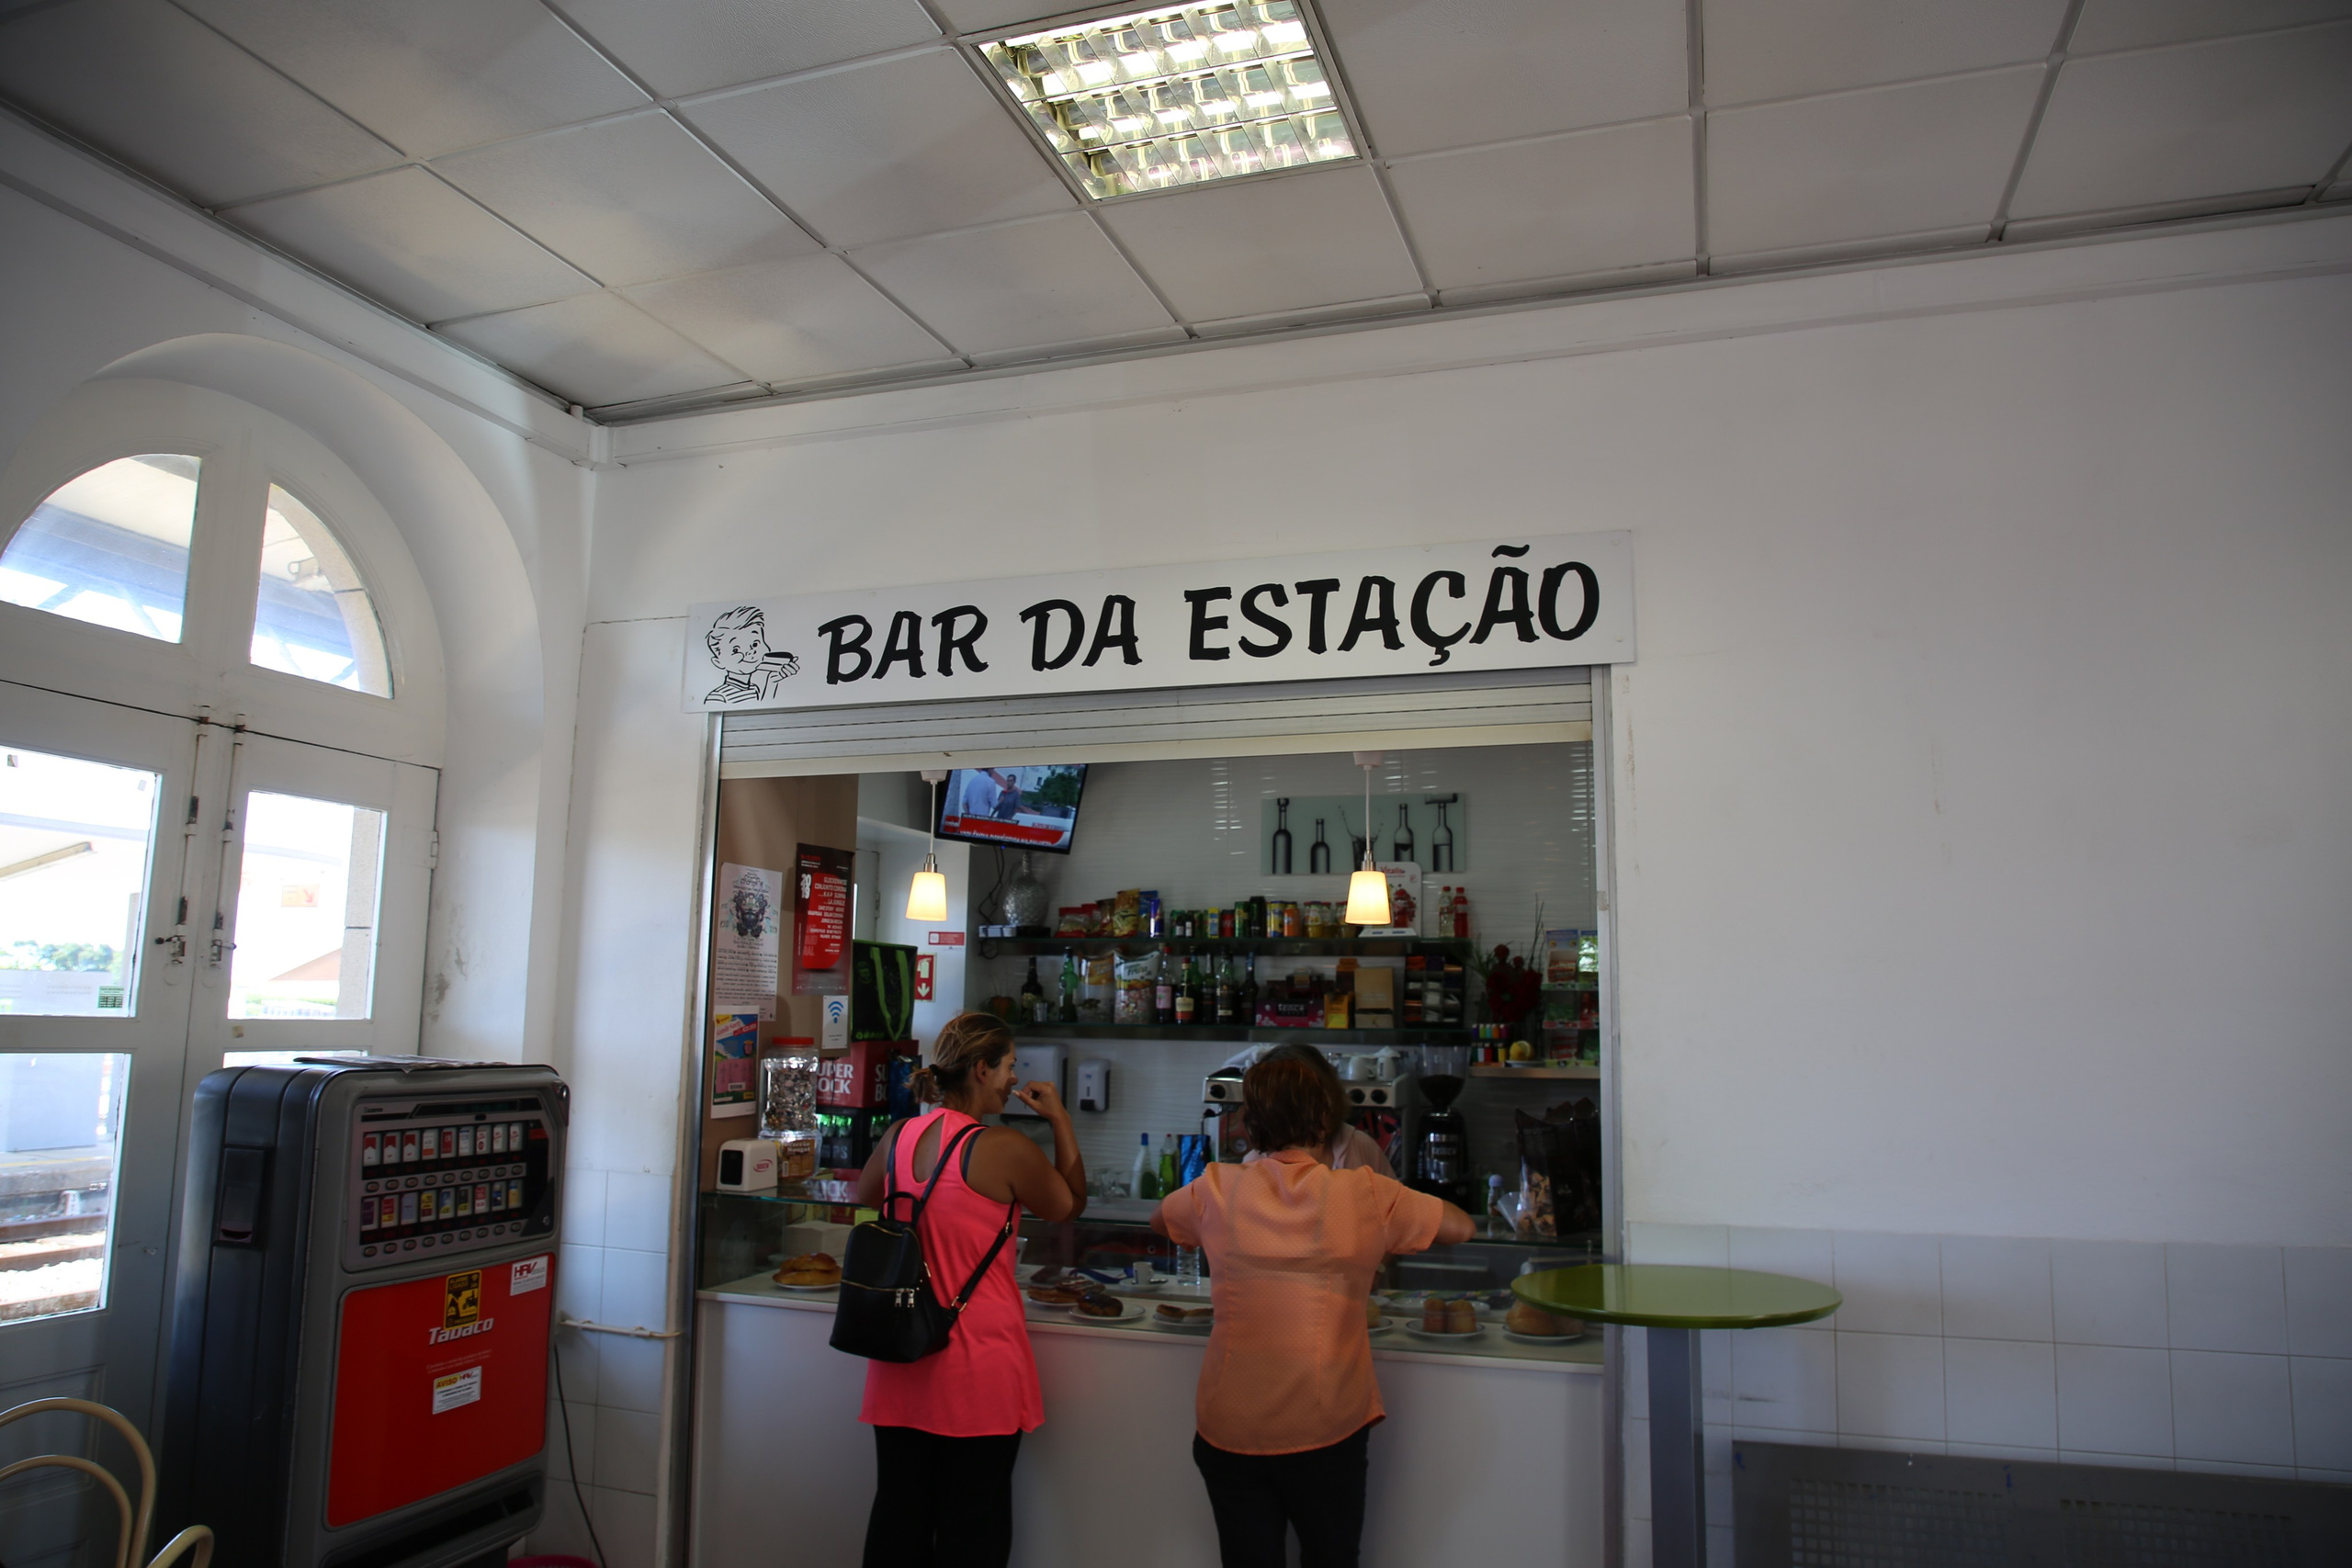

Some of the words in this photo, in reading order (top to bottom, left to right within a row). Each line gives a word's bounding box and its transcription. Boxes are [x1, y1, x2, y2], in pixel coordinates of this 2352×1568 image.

[818, 604, 989, 685] BAR
[1019, 594, 1143, 671] DA
[1184, 544, 1600, 667] ESTAÇÃO
[817, 1062, 854, 1078] UPER
[818, 1077, 851, 1094] OCK
[514, 1261, 537, 1278] HRV
[435, 1377, 458, 1389] AVISO
